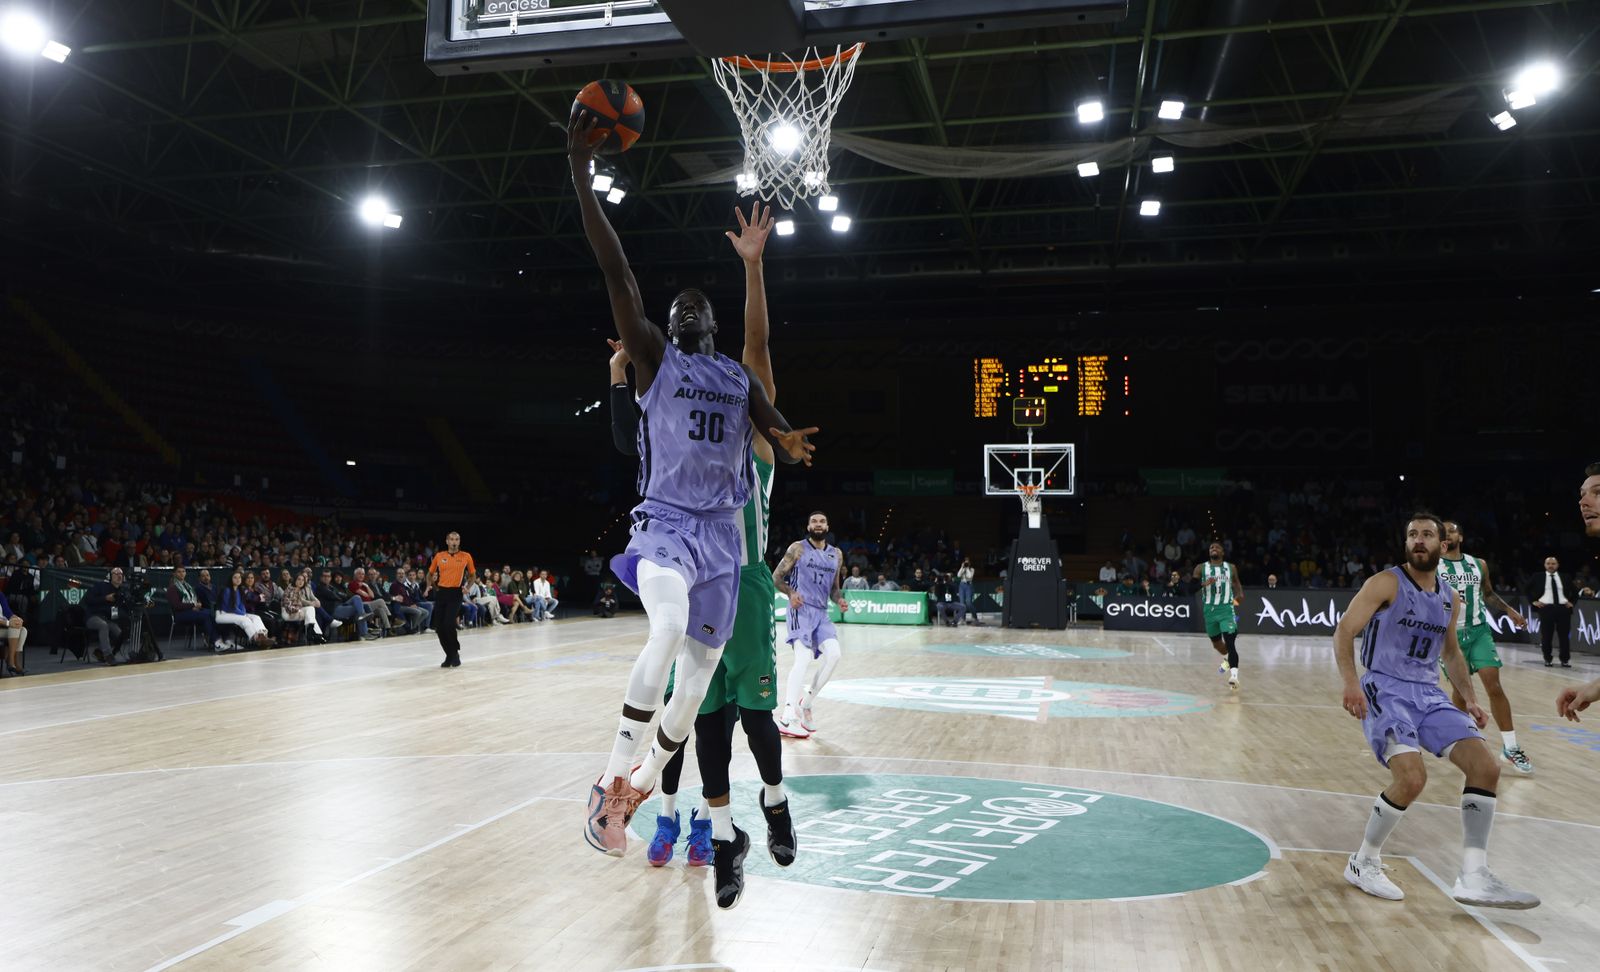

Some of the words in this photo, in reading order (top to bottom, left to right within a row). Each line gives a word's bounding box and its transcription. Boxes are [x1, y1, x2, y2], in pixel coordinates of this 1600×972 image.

[488, 0, 551, 13] endesa
[1224, 383, 1361, 403] SEVILLA
[689, 410, 725, 443] 30
[1017, 557, 1051, 565] FOREVER
[1022, 564, 1047, 572] GREEN
[813, 571, 824, 585] 17
[1441, 572, 1479, 582] Sevilla
[868, 600, 922, 615] hummel
[1106, 600, 1190, 619] endesa
[1406, 635, 1432, 659] 13
